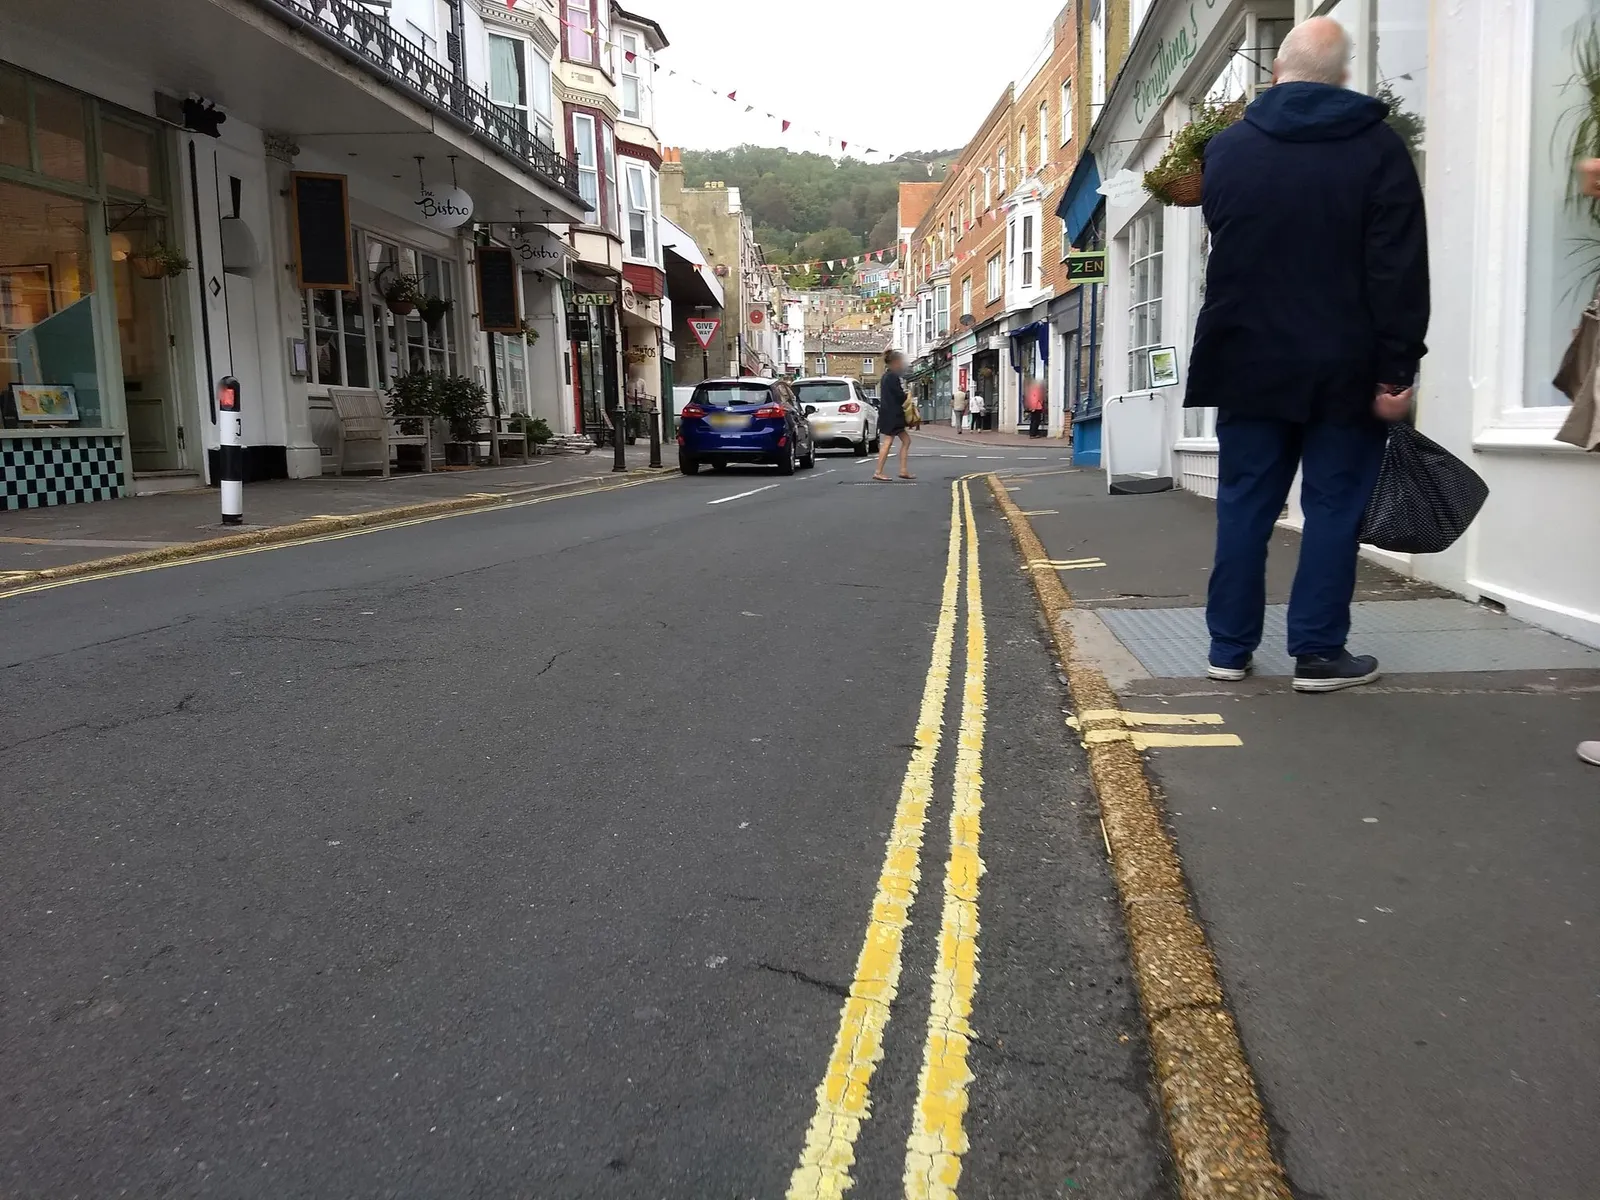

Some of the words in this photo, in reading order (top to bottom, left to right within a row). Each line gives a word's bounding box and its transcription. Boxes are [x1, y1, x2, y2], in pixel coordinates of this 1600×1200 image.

[414, 197, 469, 219] Bistro
[514, 243, 559, 261] Bistro
[1071, 260, 1104, 273] ZEN
[695, 322, 713, 330] GIVE
